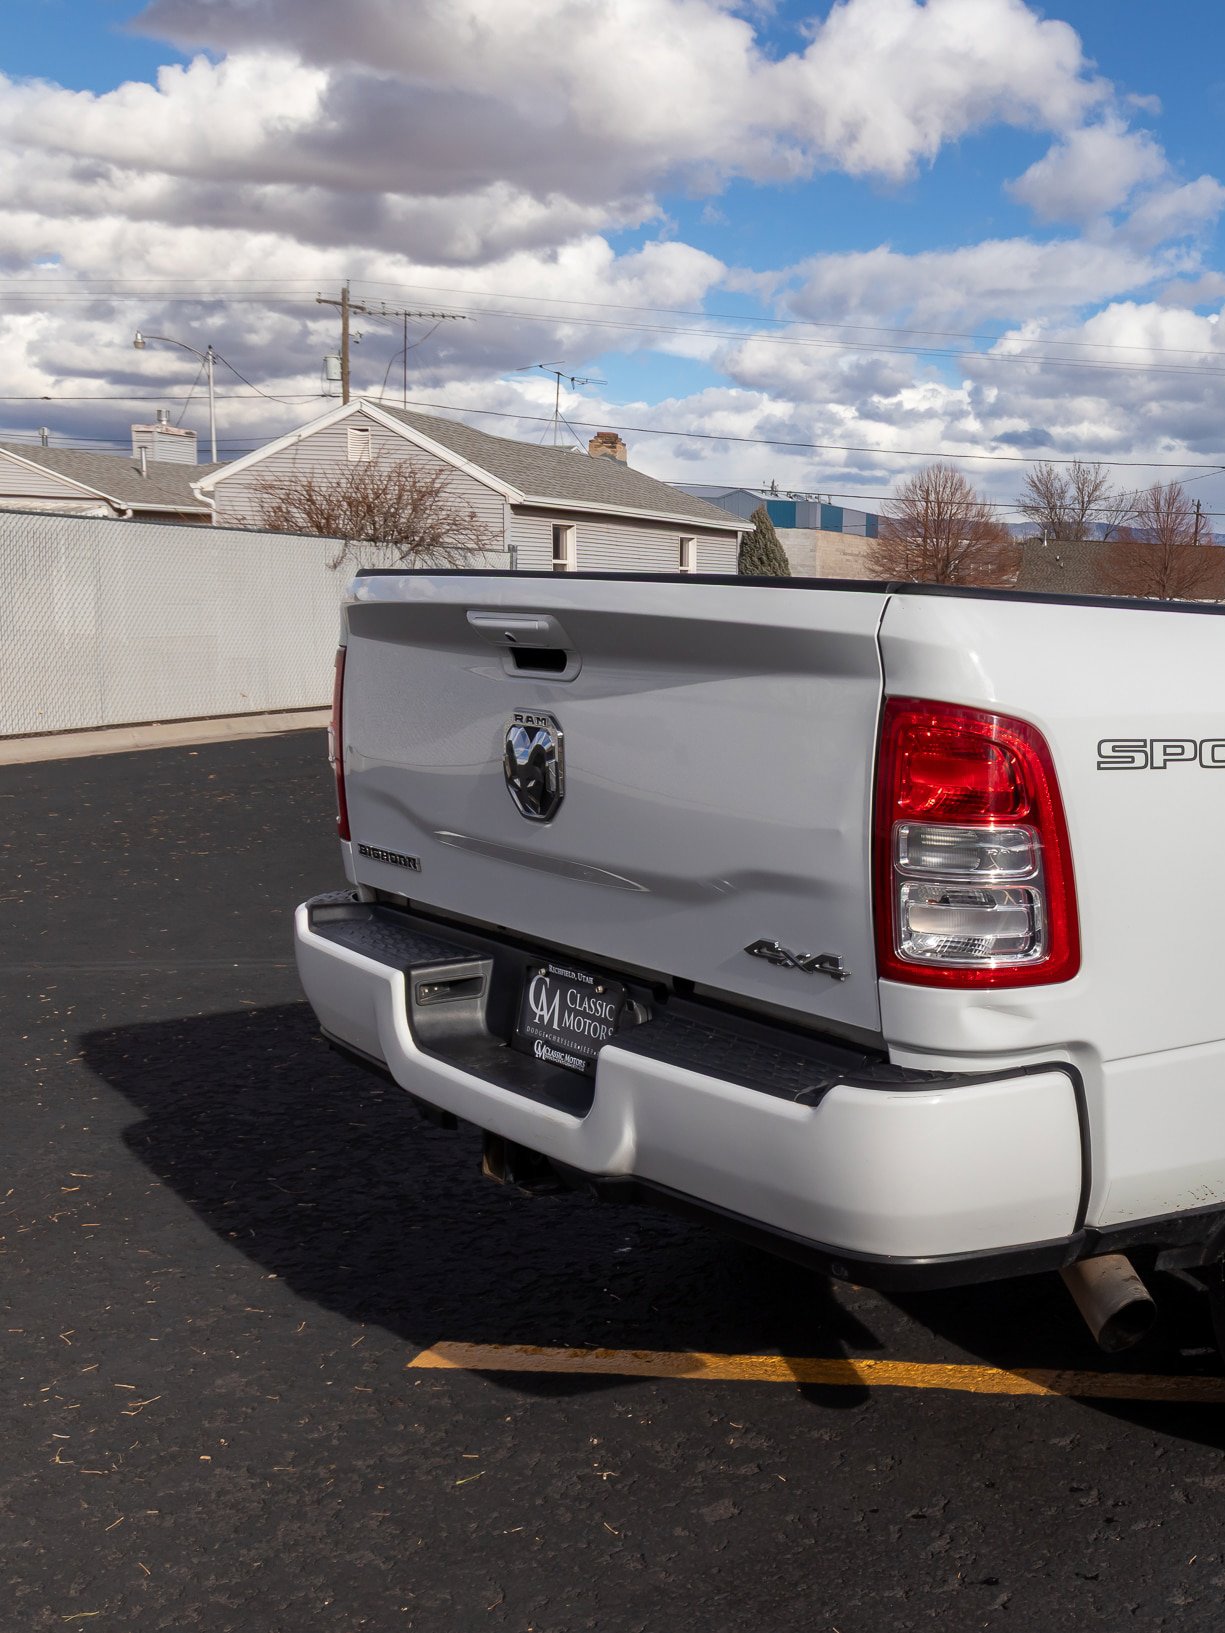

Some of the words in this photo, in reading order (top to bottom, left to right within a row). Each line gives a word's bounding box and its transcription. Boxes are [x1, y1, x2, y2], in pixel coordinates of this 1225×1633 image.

[513, 713, 548, 726] RAM
[567, 989, 615, 1021] CLASSIC
[564, 1053, 586, 1068] MOTORS
